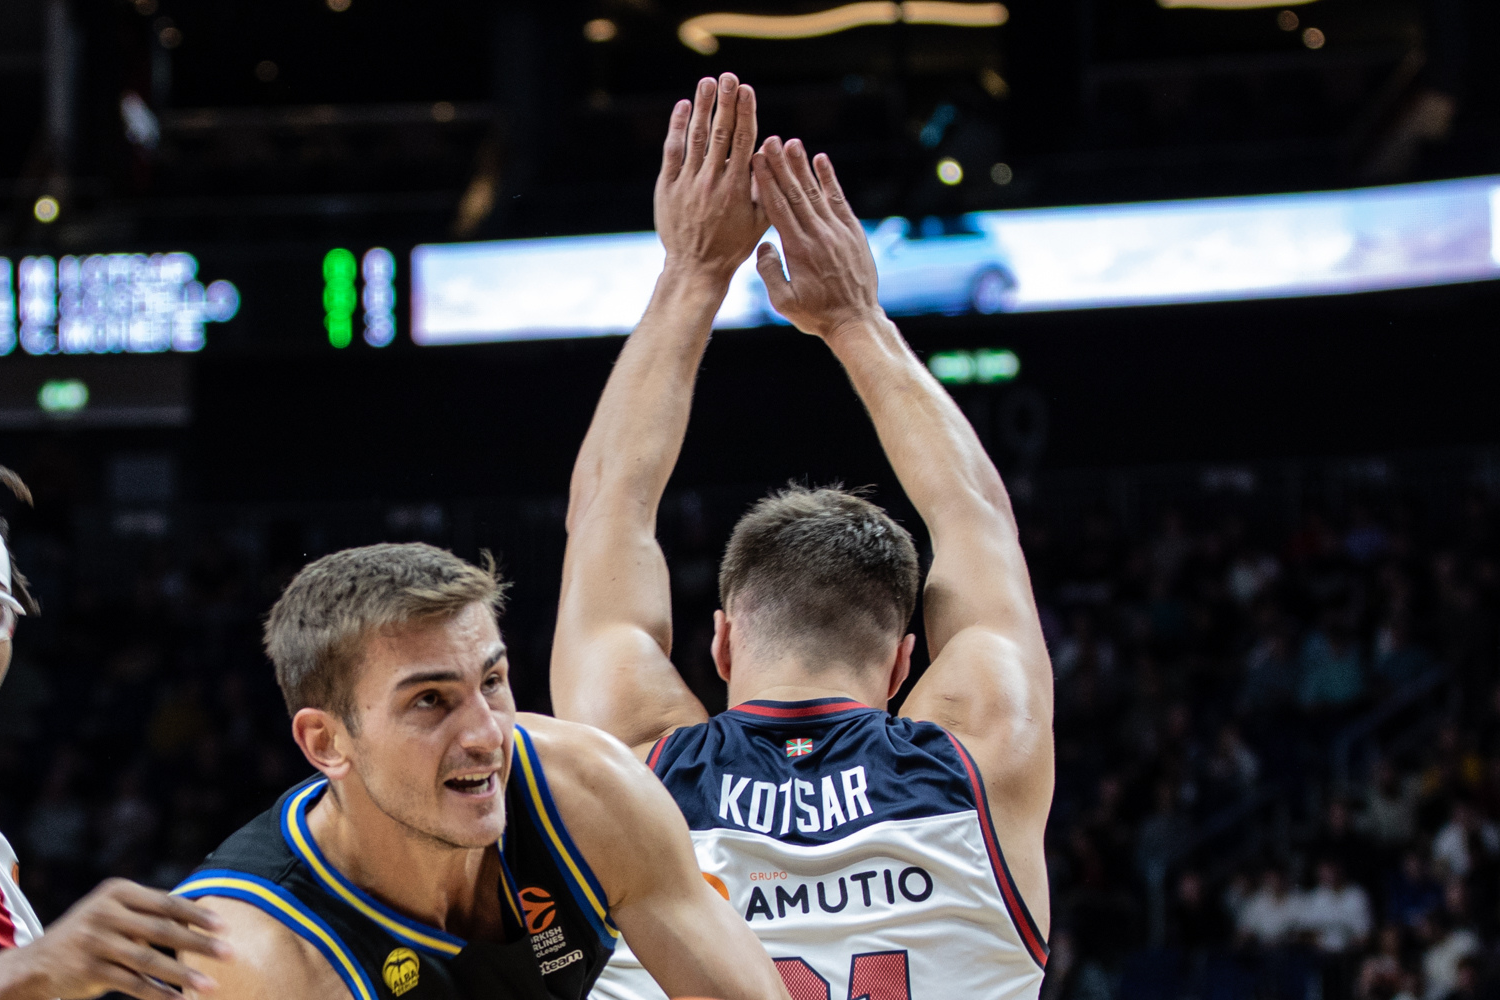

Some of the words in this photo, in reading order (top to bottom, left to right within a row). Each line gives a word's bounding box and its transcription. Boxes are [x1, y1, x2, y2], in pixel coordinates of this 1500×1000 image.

[718, 765, 873, 836] KOTSAR
[749, 871, 788, 882] GRUPO
[745, 866, 934, 922] AMUTIO
[530, 926, 563, 944] RKISH
[540, 949, 584, 976] team
